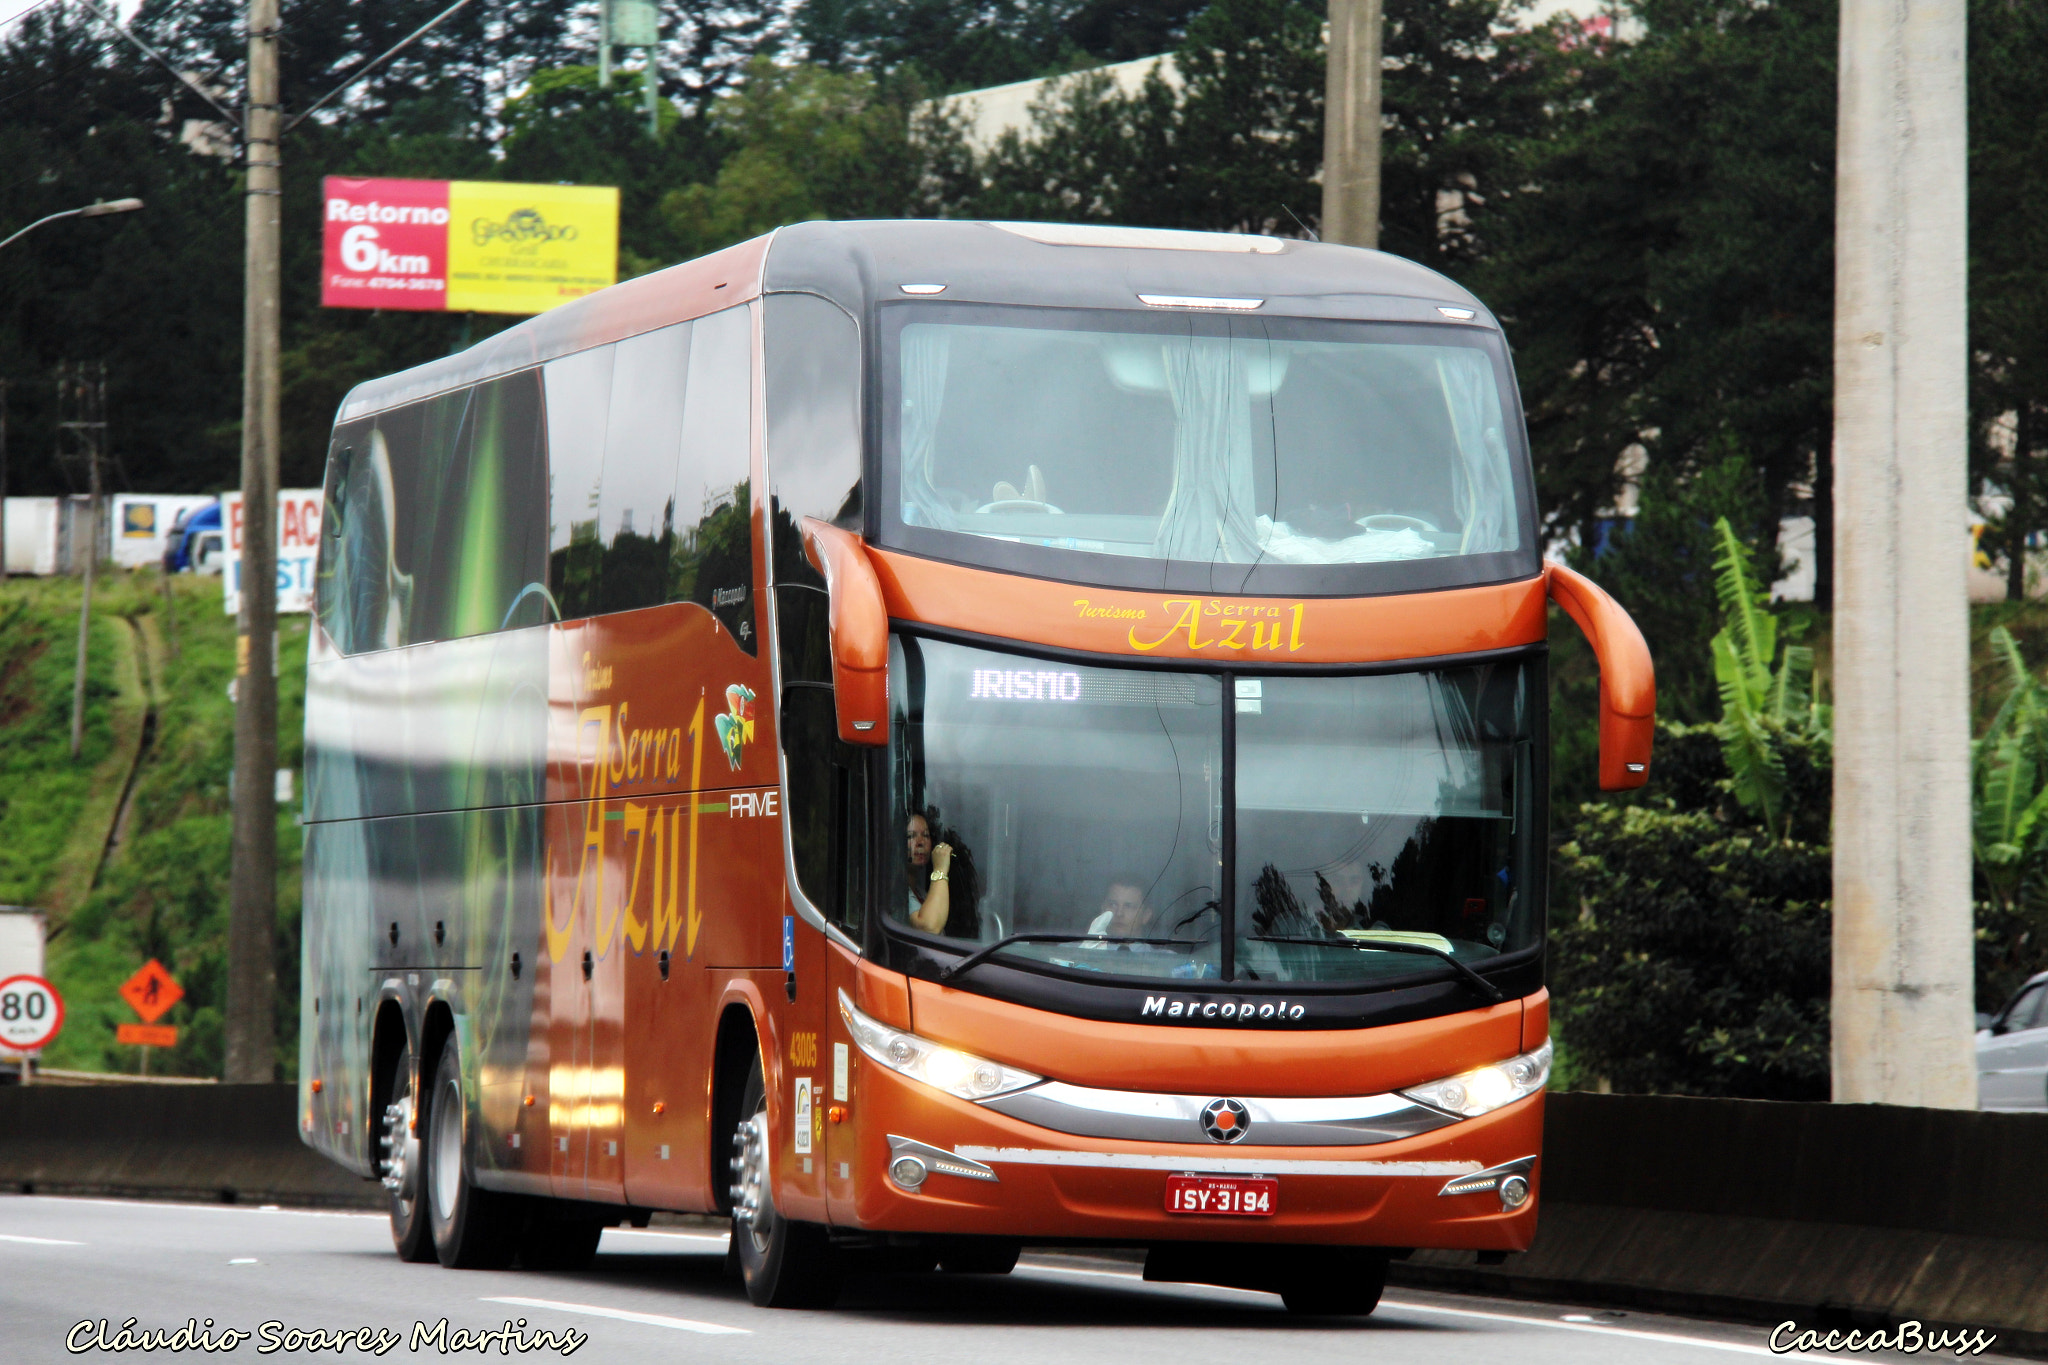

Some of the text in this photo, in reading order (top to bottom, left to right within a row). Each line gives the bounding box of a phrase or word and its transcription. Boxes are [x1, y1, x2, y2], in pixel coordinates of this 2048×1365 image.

[326, 198, 450, 225] Retorno
[1073, 599, 1281, 620] Turismo Serra
[1128, 599, 1305, 652] Azul
[610, 702, 681, 788] Serra
[730, 791, 778, 818] PRIME
[545, 697, 705, 966] Azul
[1, 991, 46, 1021] 80
[1141, 995, 1306, 1022] Marcopolo
[789, 1031, 817, 1068] 43005
